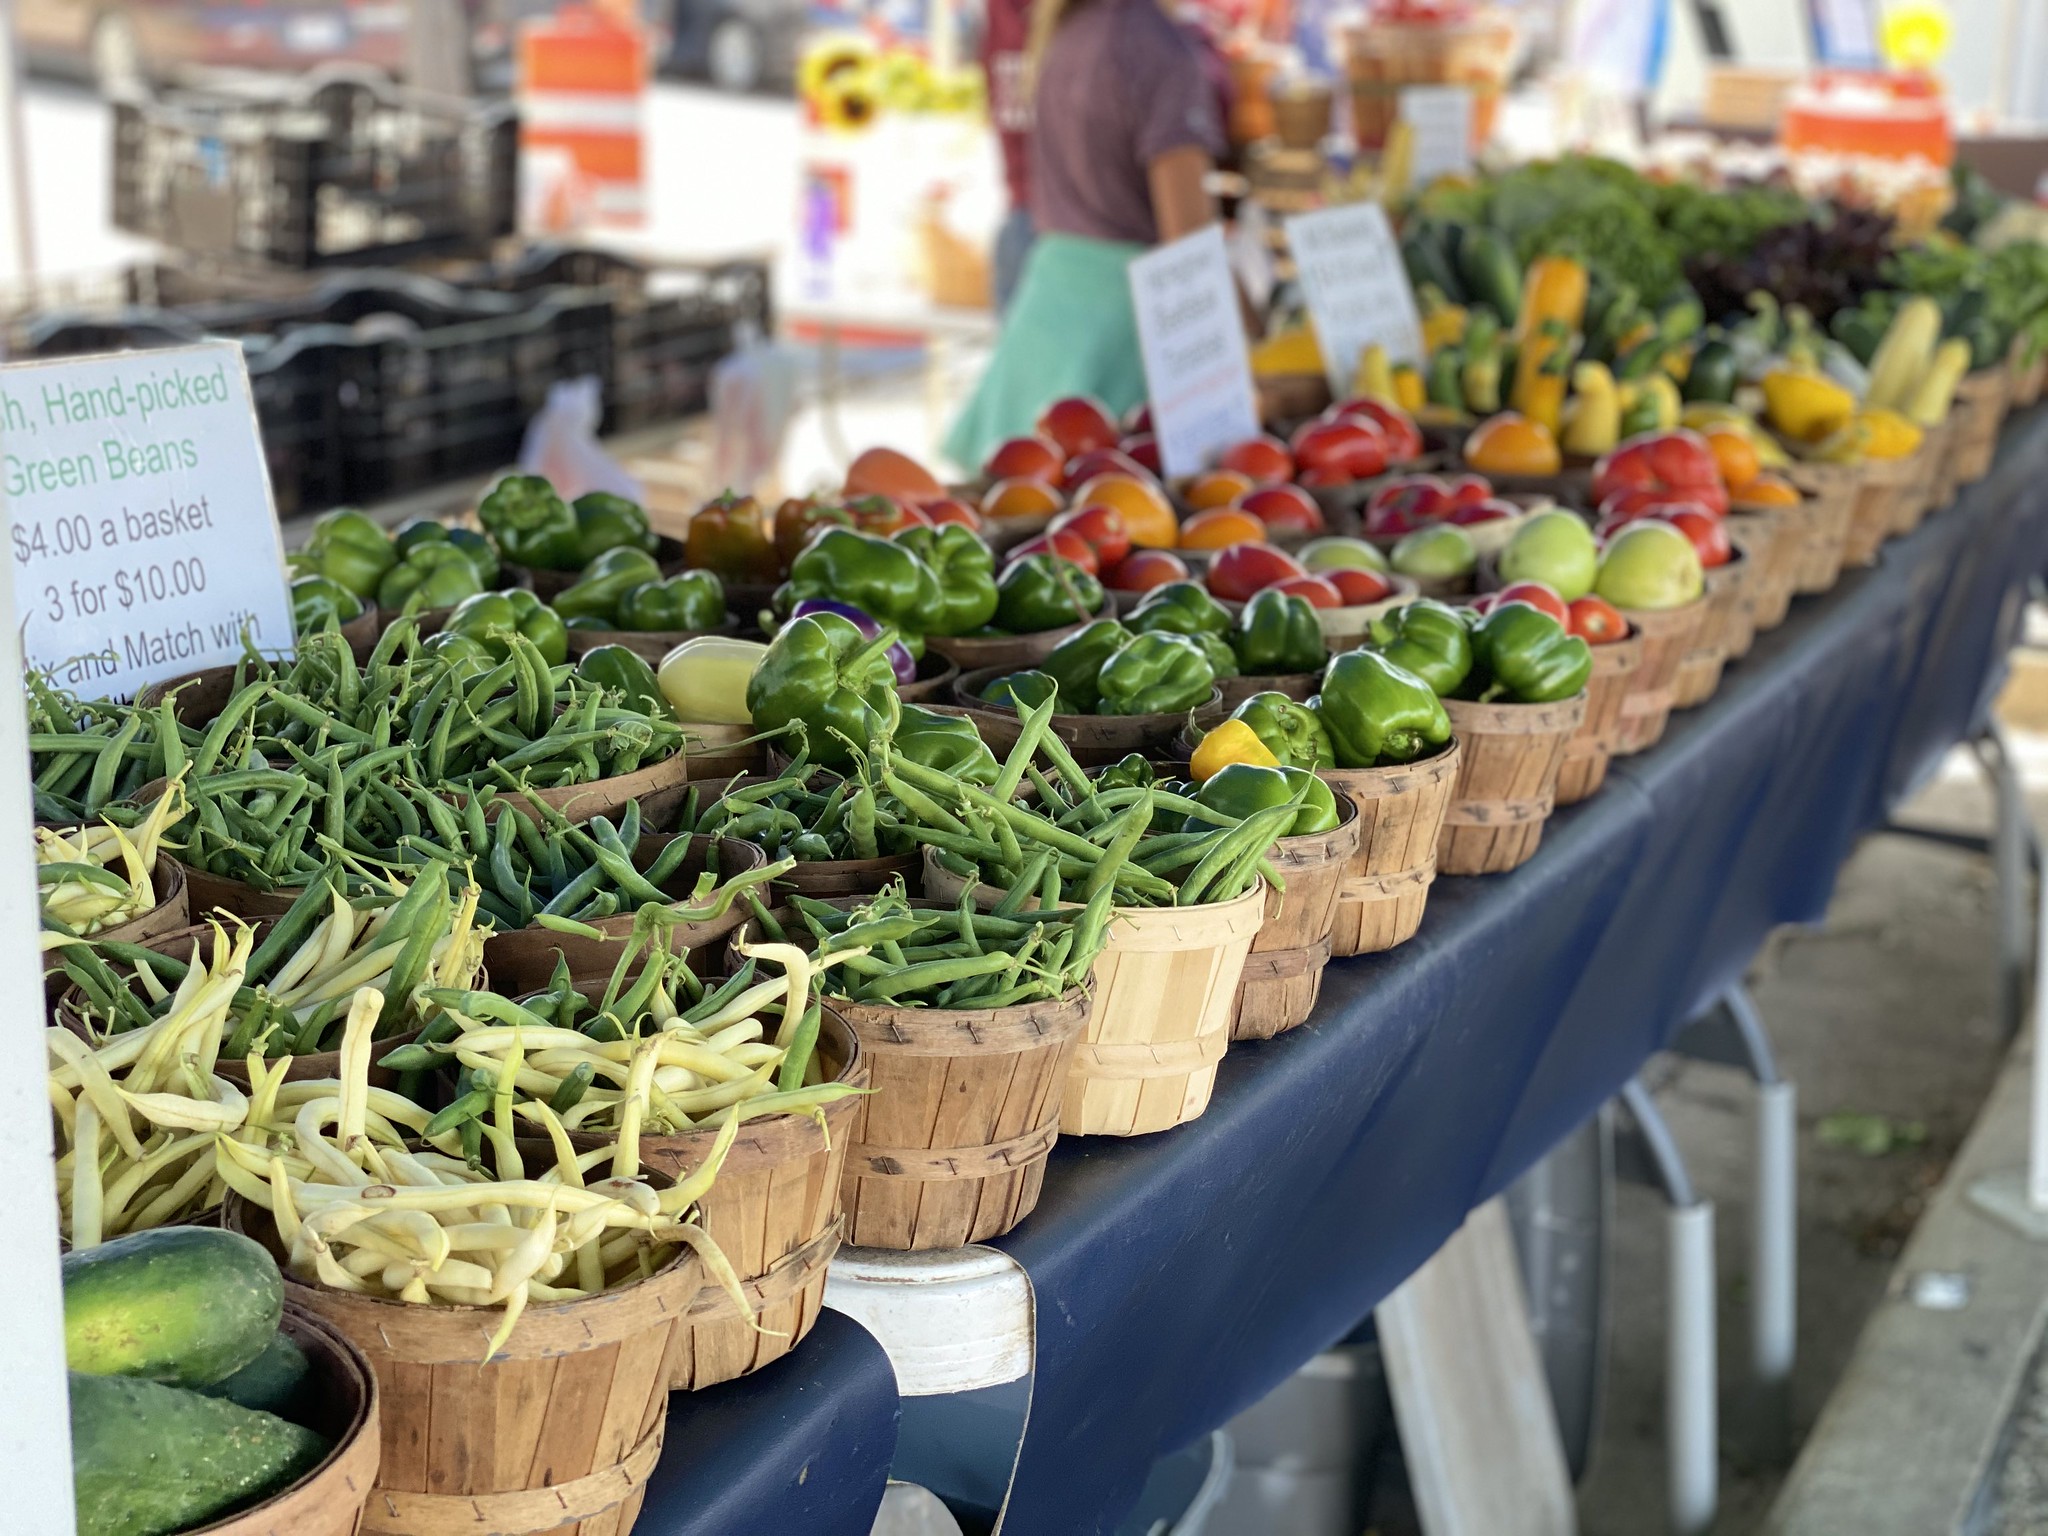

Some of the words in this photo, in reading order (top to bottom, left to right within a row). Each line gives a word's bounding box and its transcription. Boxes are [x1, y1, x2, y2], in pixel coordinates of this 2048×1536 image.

[0, 390, 37, 436] h,
[41, 362, 229, 426] Hand-picked
[3, 454, 98, 496] Green
[102, 439, 198, 480] Beans
[11, 514, 92, 567] $4.00
[100, 519, 119, 547] a
[123, 494, 214, 542] basket
[45, 585, 64, 622] 3
[70, 579, 107, 617] for
[115, 557, 206, 611] $10.00
[68, 638, 118, 684] and
[124, 621, 204, 670] Match
[211, 608, 261, 648] with
